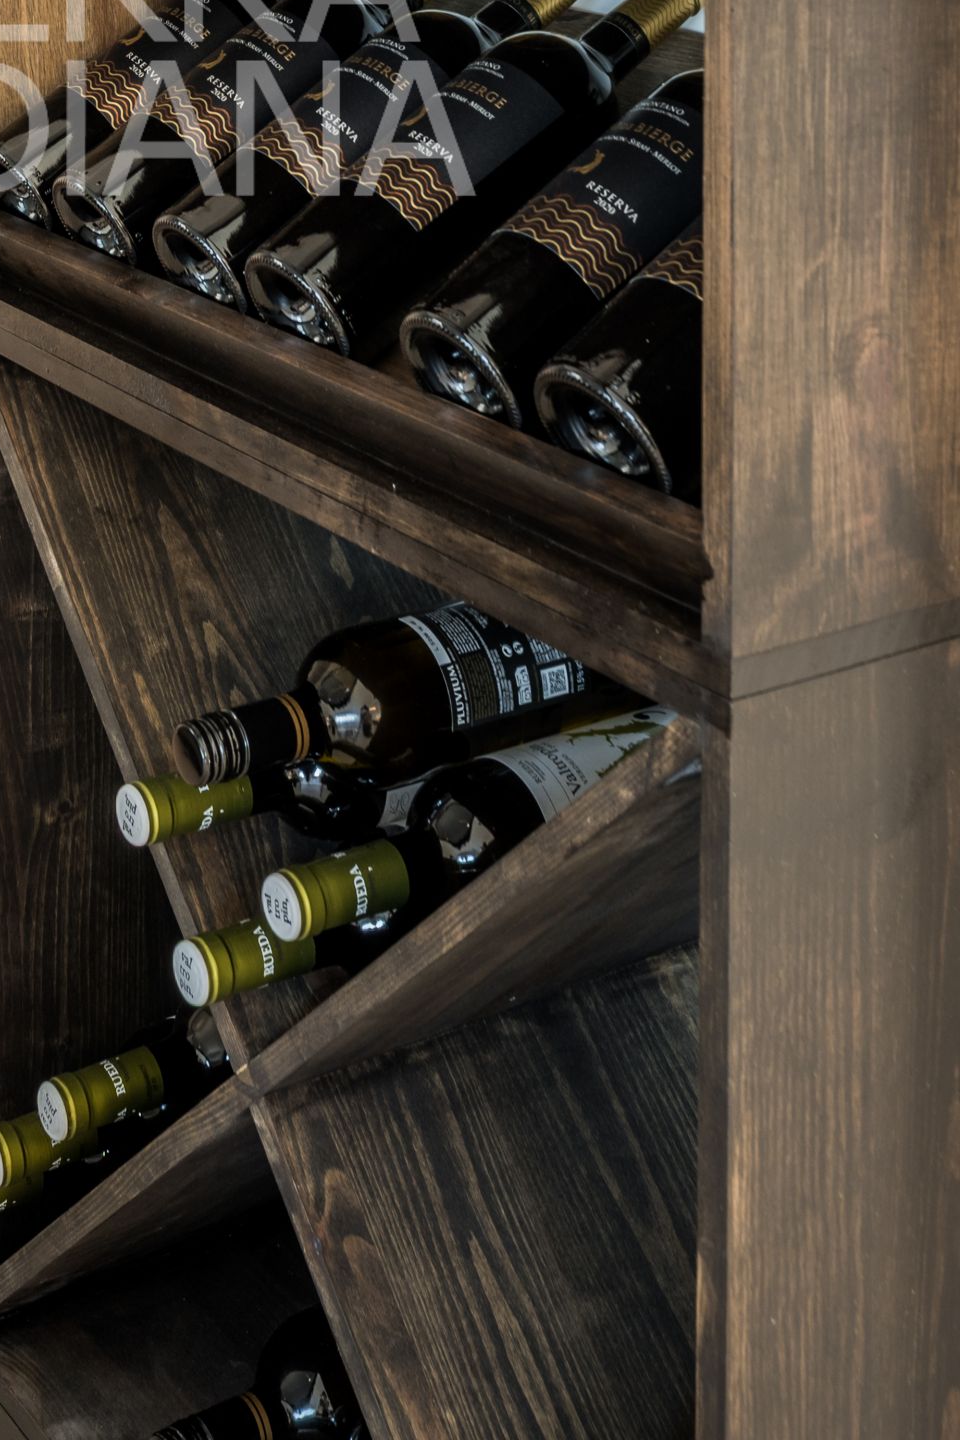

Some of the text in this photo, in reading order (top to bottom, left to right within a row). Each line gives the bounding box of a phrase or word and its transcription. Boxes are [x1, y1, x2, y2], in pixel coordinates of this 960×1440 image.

[125, 51, 160, 85] RESERVA
[206, 75, 245, 109] RESERVA
[315, 106, 359, 143] RESERVA
[408, 129, 454, 164] RESERVA
[585, 180, 639, 224] RESERVA
[446, 664, 466, 726] PLUVIUM
[350, 864, 368, 917] RUEDA
[253, 925, 275, 978] RUEDA
